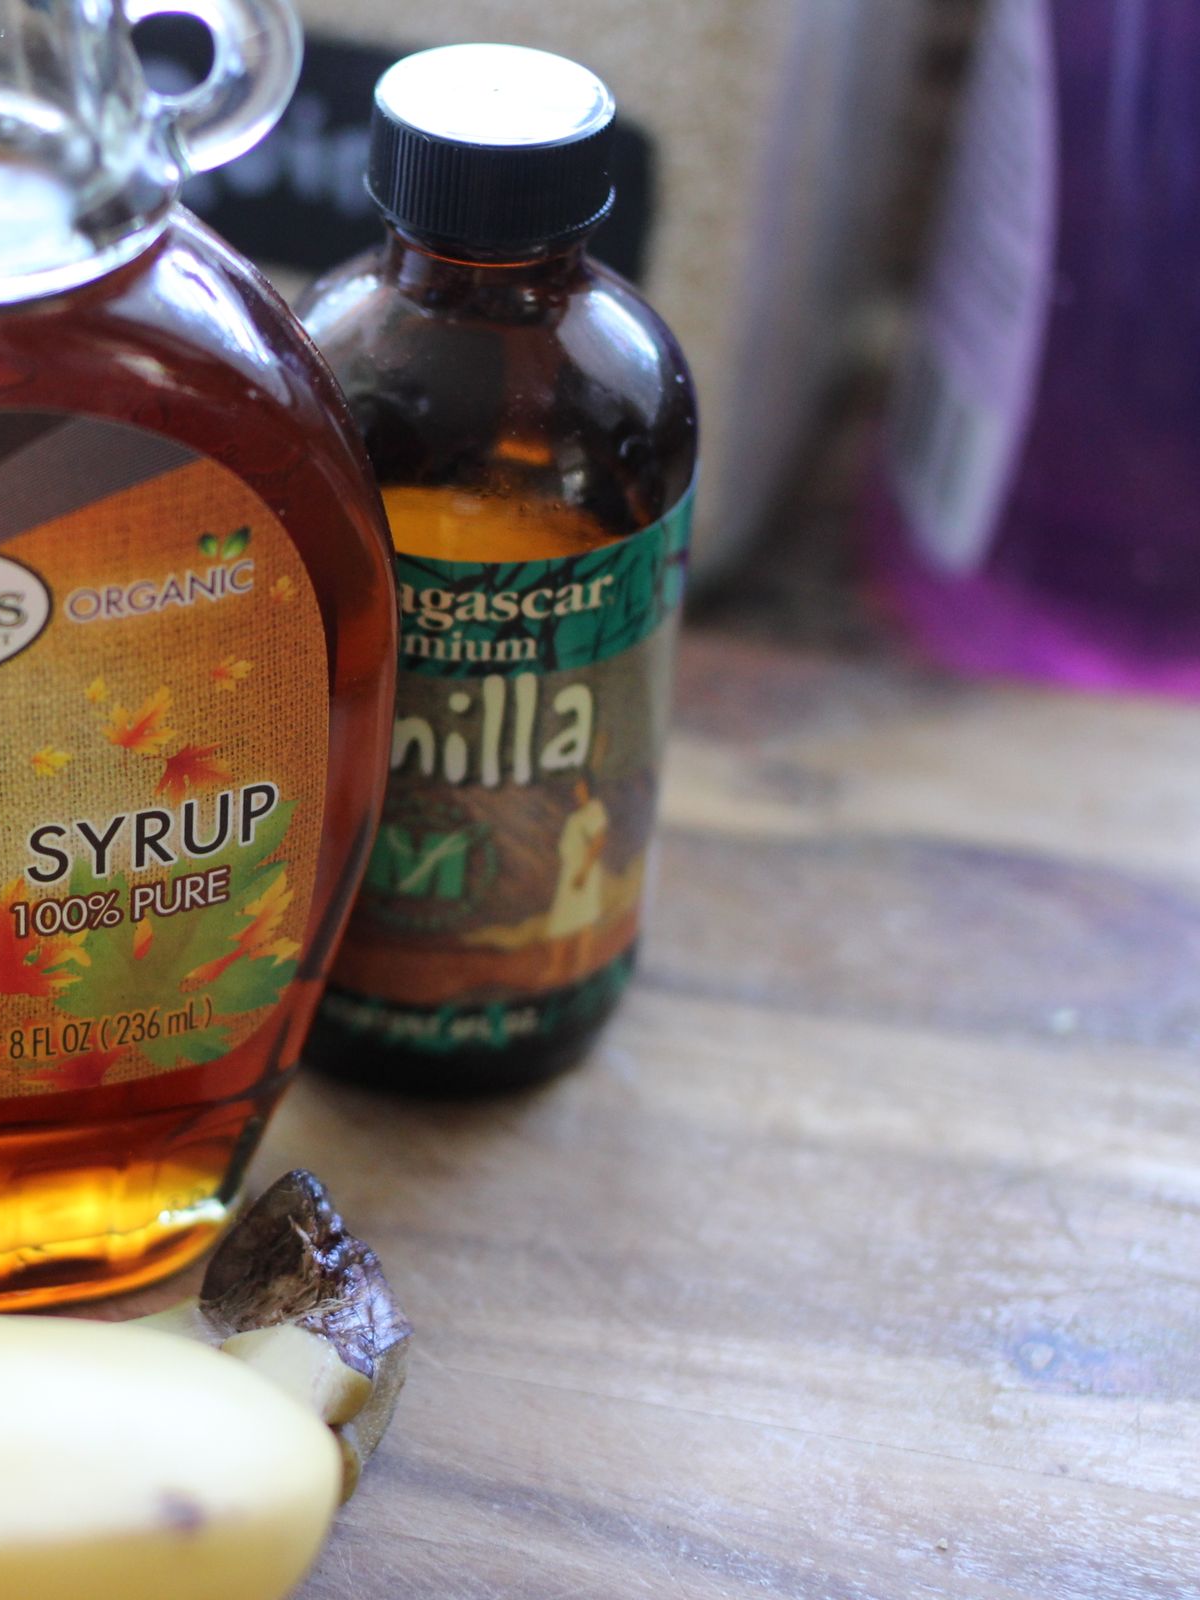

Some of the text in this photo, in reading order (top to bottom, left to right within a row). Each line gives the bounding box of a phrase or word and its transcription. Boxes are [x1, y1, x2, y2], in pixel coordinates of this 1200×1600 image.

[67, 561, 254, 621] ORGANIC
[27, 782, 278, 883] SYRUP
[12, 891, 121, 939] 100%
[133, 867, 230, 923] PURE
[9, 1029, 25, 1058] 8
[32, 1027, 57, 1057] FL
[61, 1022, 93, 1054] OZ
